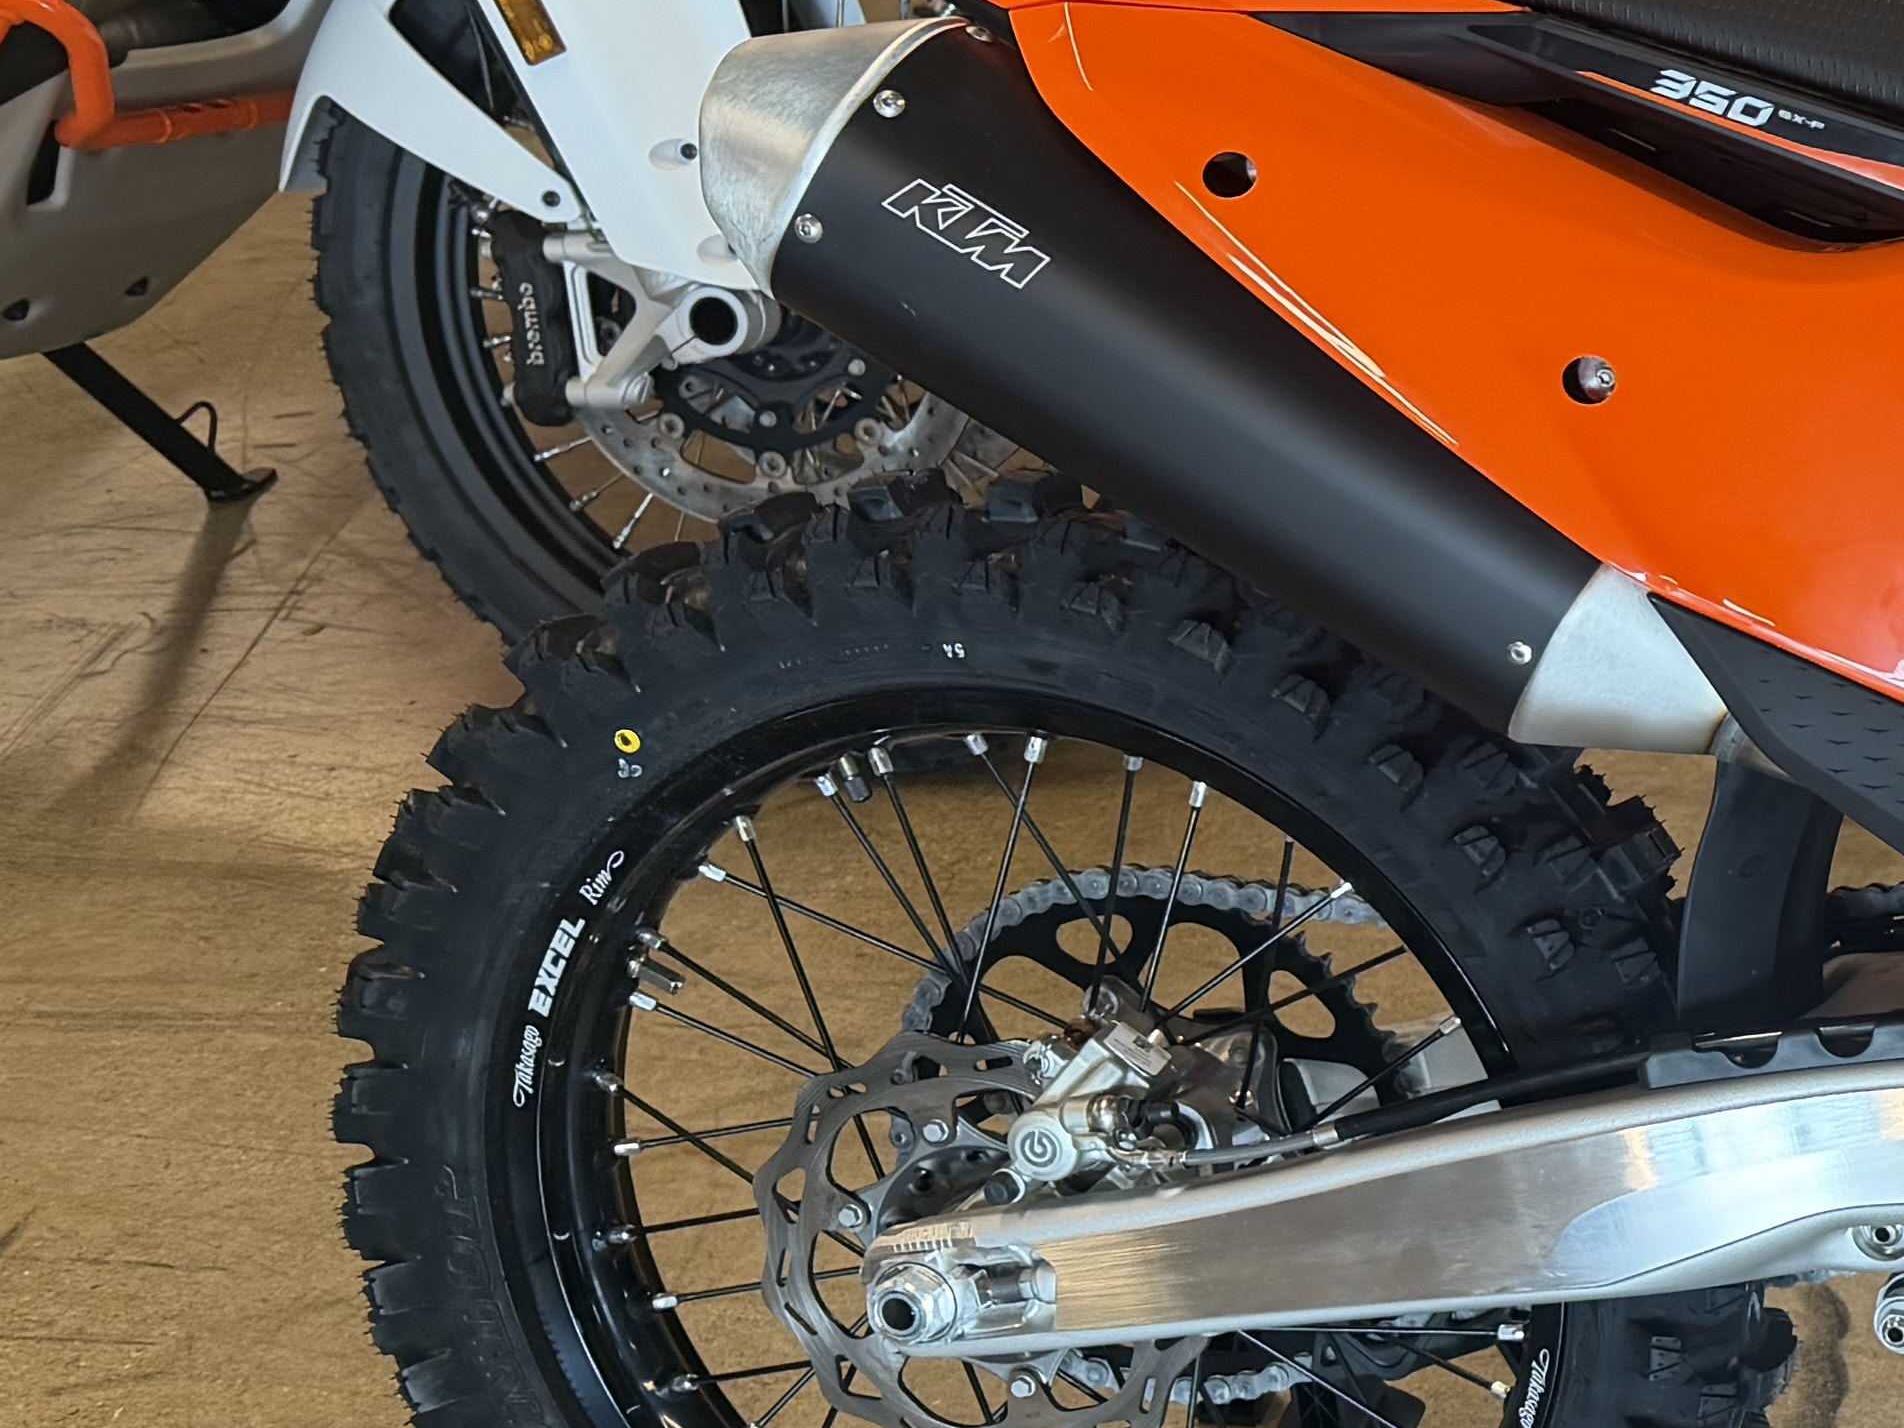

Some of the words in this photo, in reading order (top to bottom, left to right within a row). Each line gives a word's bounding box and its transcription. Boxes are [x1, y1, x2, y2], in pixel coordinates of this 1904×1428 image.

[1650, 68, 1775, 127] 350
[881, 178, 1051, 290] KTM
[519, 282, 545, 367] brembo
[512, 1024, 541, 1109] Takasago
[527, 917, 586, 1018] EXCEL
[578, 849, 625, 907] Rim
